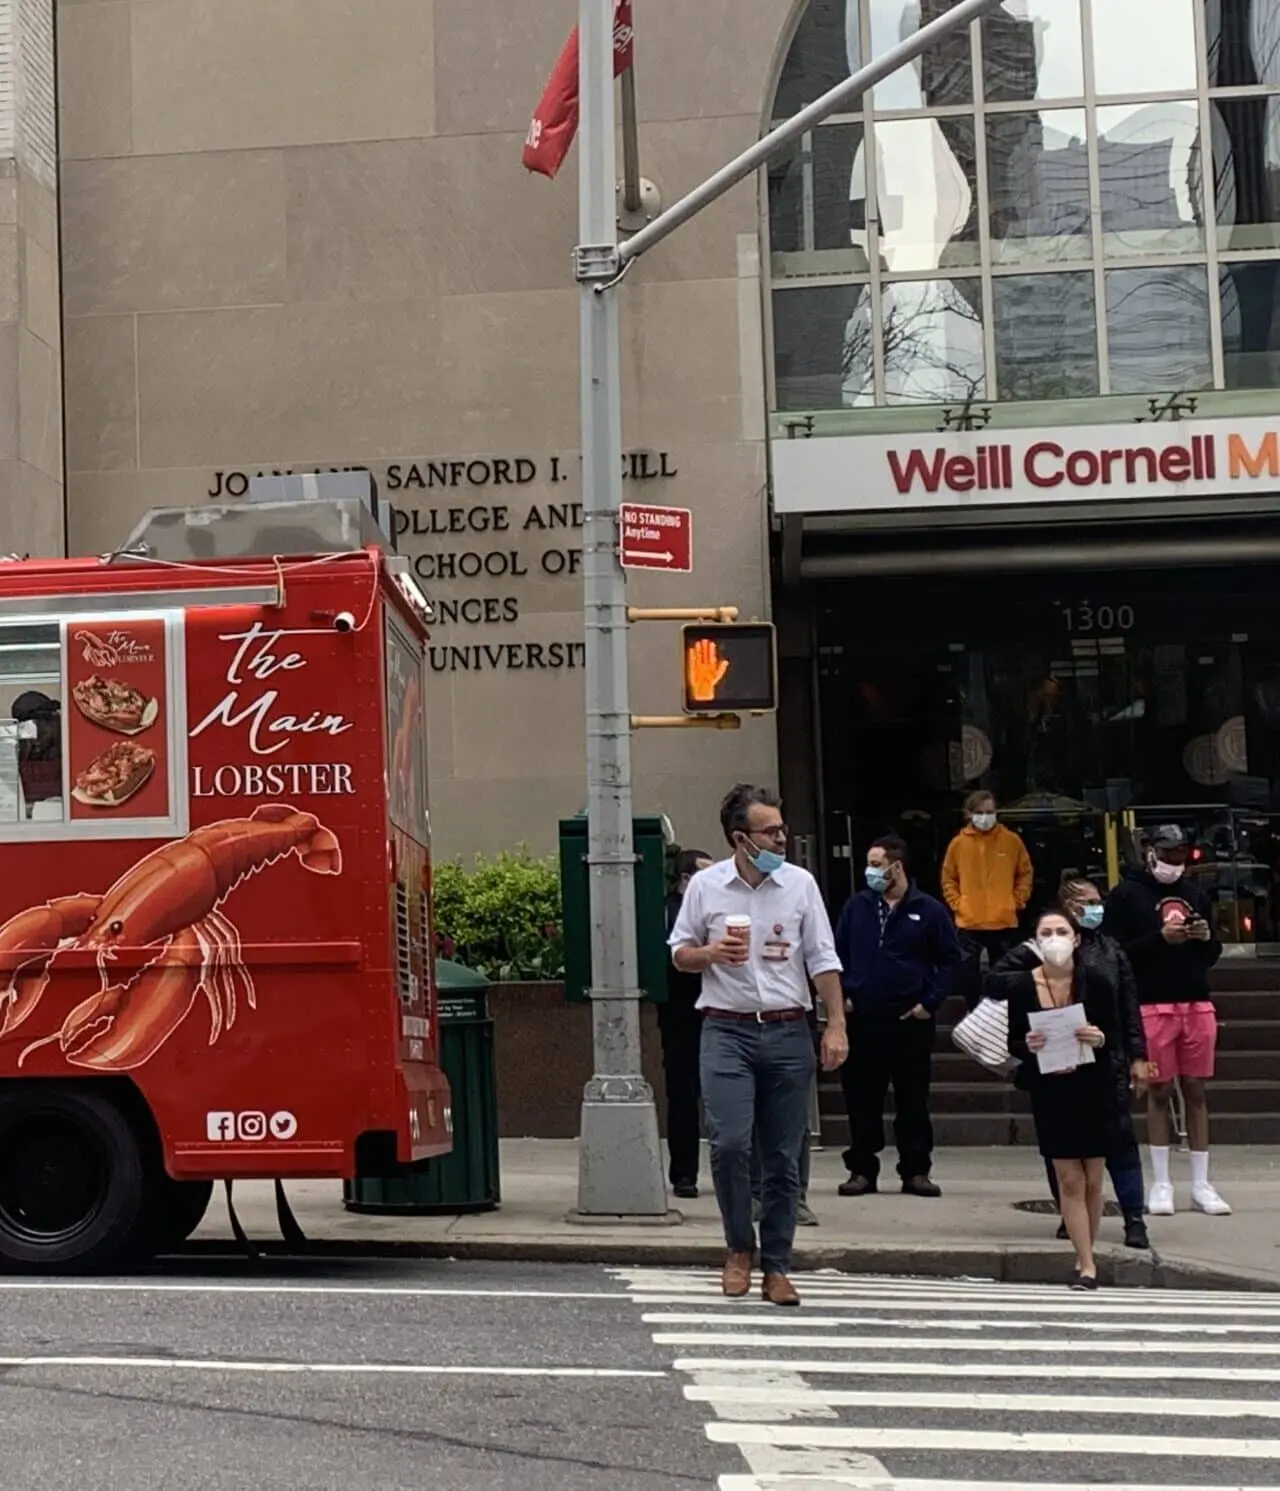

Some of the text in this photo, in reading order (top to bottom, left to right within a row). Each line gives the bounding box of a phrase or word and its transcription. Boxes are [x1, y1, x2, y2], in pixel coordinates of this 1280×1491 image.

[387, 459, 536, 490] SANFORD
[550, 458, 568, 482] I.
[887, 444, 1012, 494] Weill
[1023, 434, 1216, 488] Cornell
[394, 506, 509, 535] OLLEGE
[624, 511, 681, 528] NO STANDING
[624, 526, 660, 541] Anytime
[408, 549, 582, 579] CHOOL OF
[423, 597, 519, 625] ENCES
[1062, 605, 1134, 631] 1300
[429, 642, 586, 672] UNIVERSIT
[189, 690, 353, 755] Main
[191, 763, 356, 797] LOBSTER
